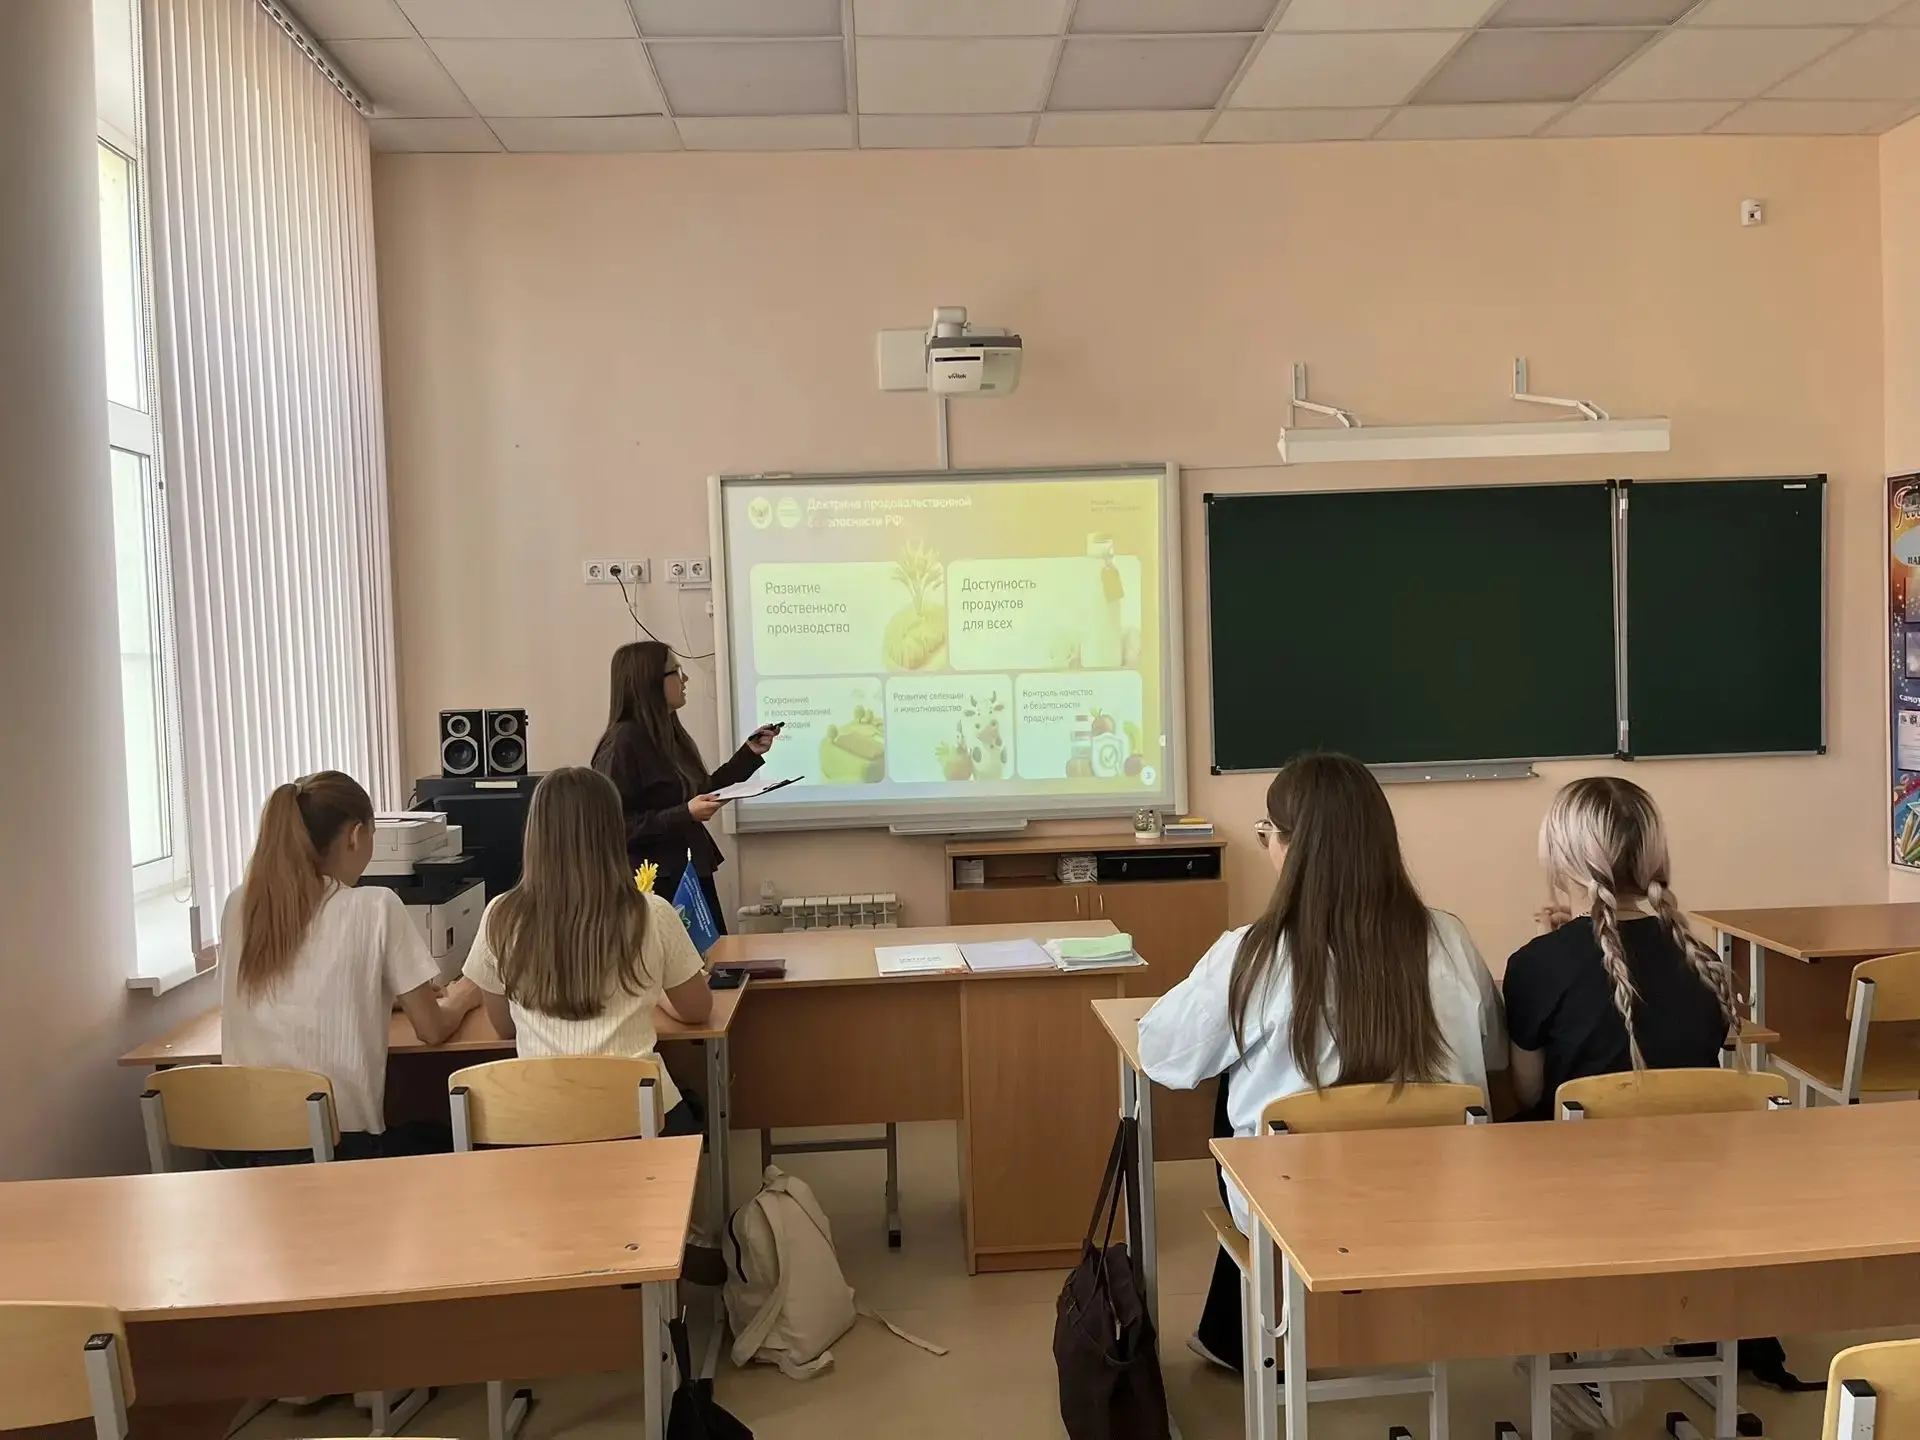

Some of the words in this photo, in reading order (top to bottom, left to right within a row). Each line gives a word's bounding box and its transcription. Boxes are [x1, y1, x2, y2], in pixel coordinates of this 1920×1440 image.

[765, 581, 821, 595] Развитие
[961, 577, 1037, 593] Доступность
[766, 601, 847, 614] собственного
[962, 598, 1024, 613] продуктов
[767, 622, 850, 637] производства
[962, 619, 984, 632] для
[987, 618, 1013, 629] всех
[1022, 689, 1058, 699] Контроль
